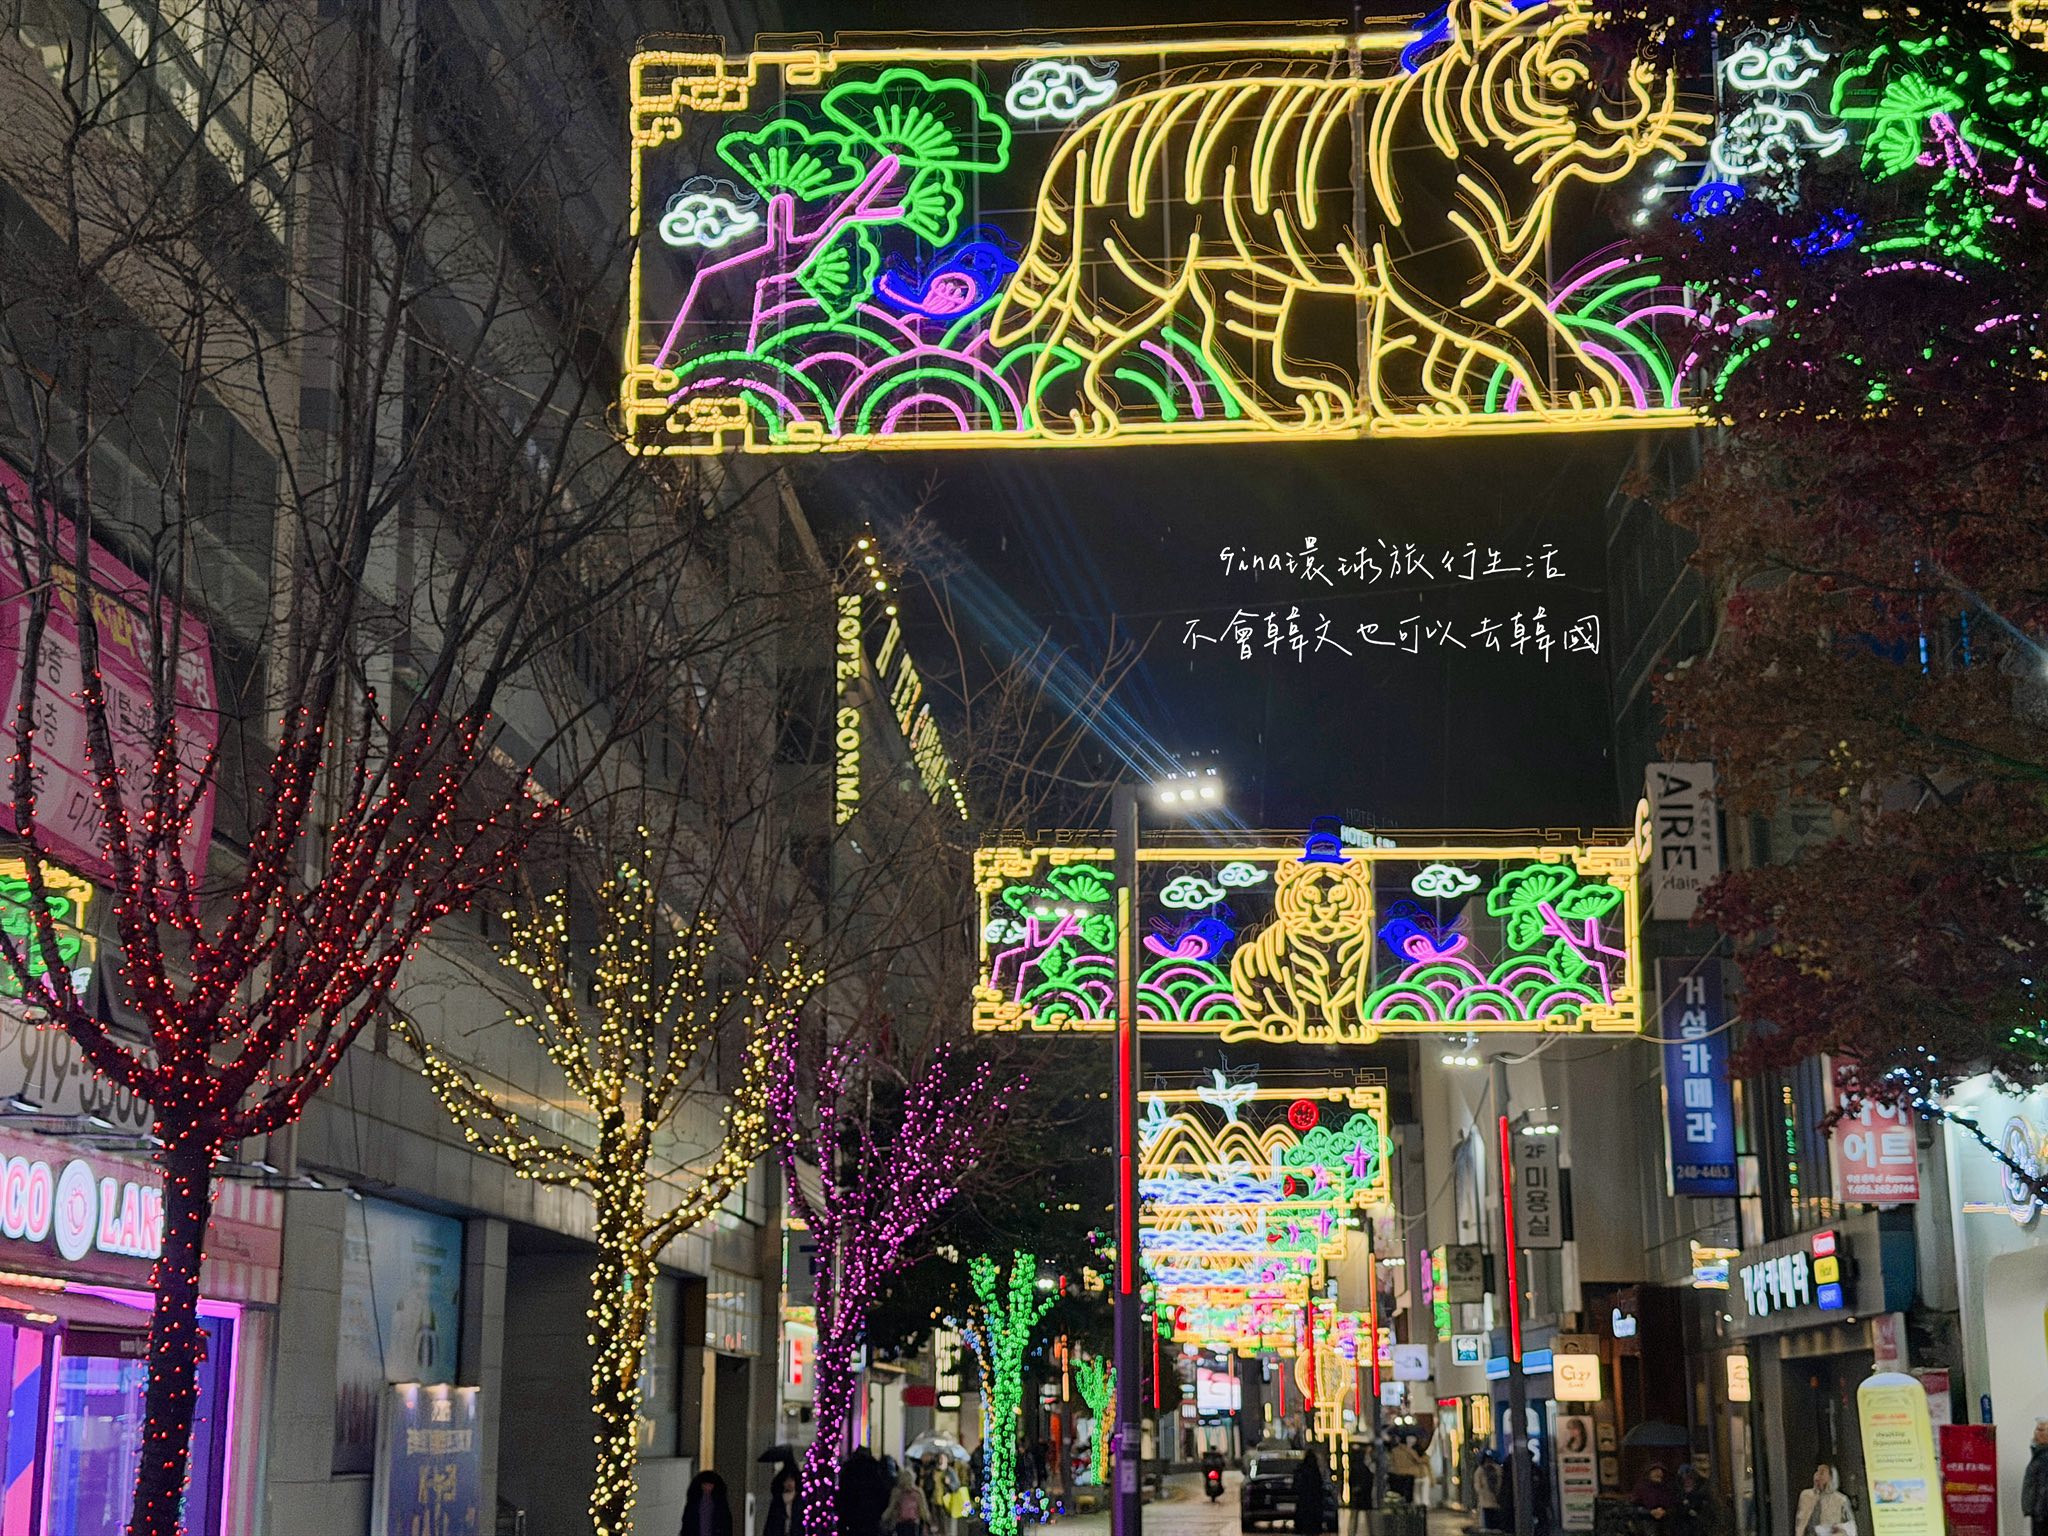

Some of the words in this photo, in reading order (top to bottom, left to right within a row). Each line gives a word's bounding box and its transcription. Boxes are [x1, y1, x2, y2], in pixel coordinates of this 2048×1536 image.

[836, 594, 861, 697] HOTE
[1656, 771, 1698, 870] AIRE
[1678, 975, 1717, 1144] 거성카메라
[1524, 1144, 1547, 1159] 2F
[1843, 1130, 1914, 1169] 어트
[0, 1156, 52, 1242] CO
[1525, 1166, 1551, 1237] 미용실
